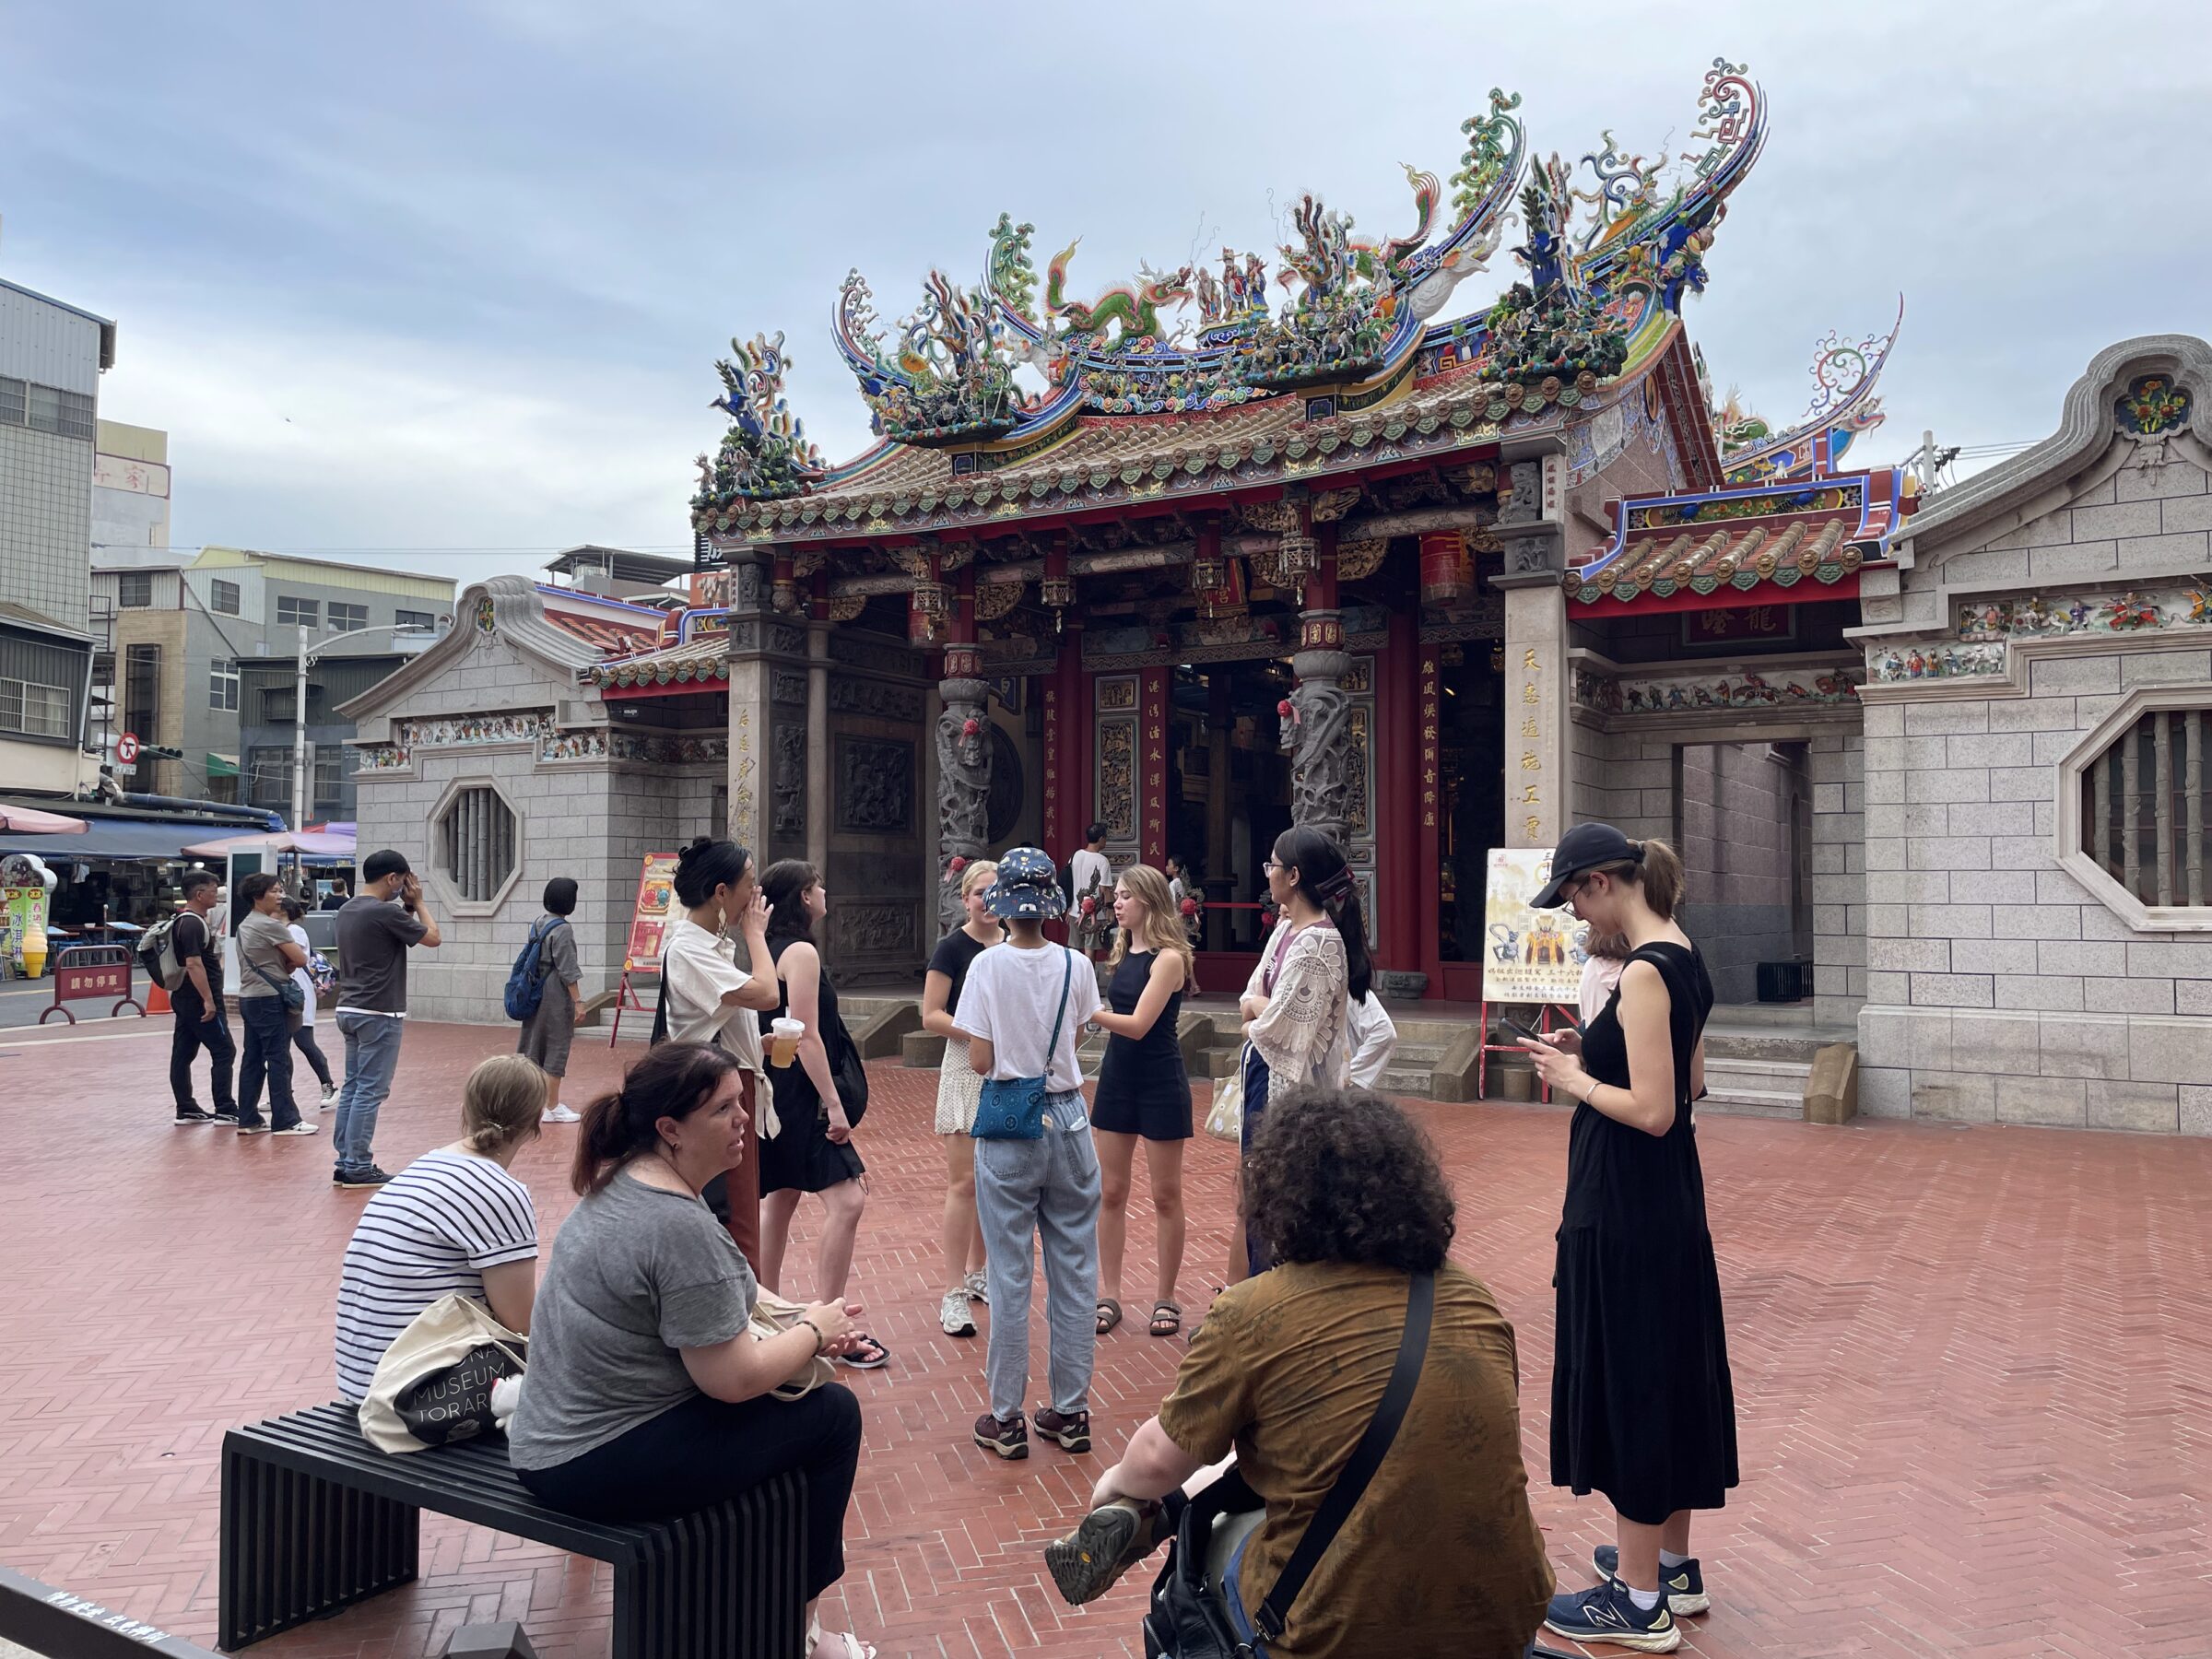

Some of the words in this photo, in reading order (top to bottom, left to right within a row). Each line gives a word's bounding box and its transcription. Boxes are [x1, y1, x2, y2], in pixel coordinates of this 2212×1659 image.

[12, 913, 23, 959] 冰淇淋
[71, 974, 117, 990] 請勿停車
[414, 1362, 505, 1406] MUSEUM
